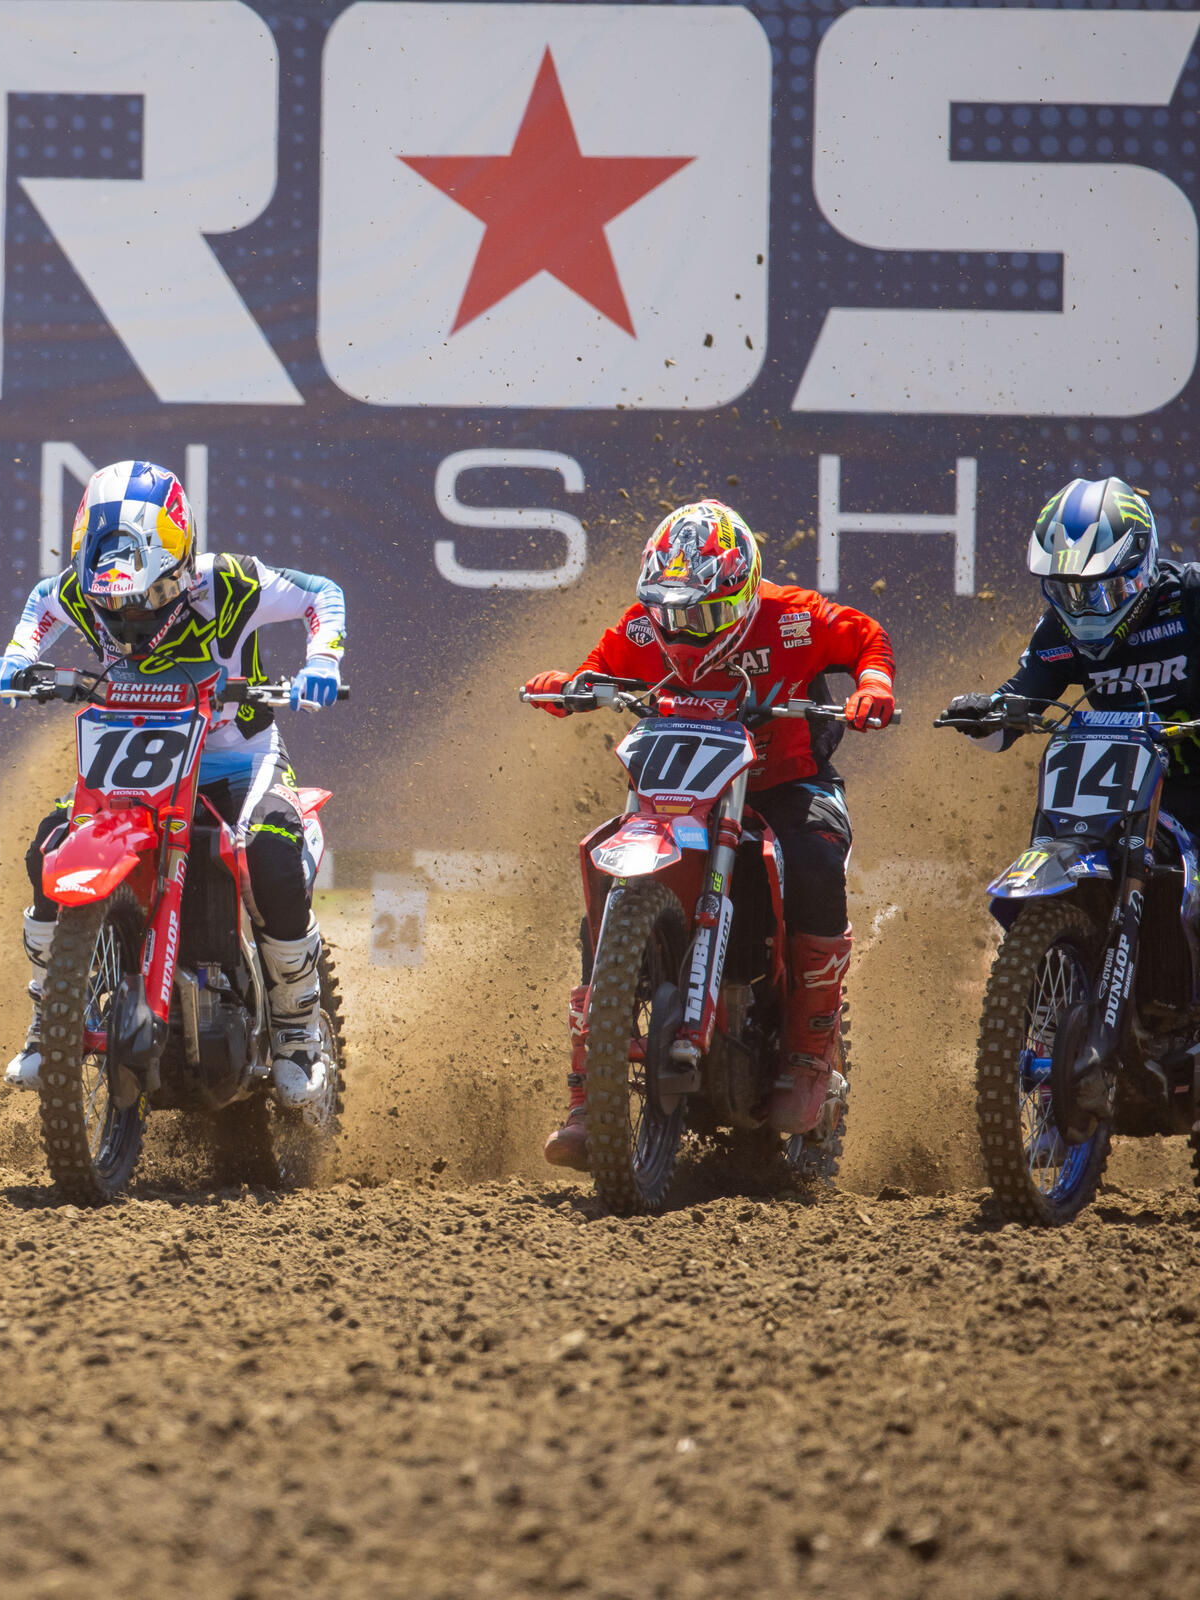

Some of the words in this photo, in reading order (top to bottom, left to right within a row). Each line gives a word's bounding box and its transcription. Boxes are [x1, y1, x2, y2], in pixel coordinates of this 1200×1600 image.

[91, 583, 112, 592] Red
[113, 583, 134, 592] Bull
[1139, 620, 1184, 643] YAMAHA
[112, 683, 183, 692] RENTHAL
[1089, 655, 1188, 695] THOR
[110, 694, 181, 702] RENTHAL
[1084, 712, 1141, 726] PROTAPER
[85, 729, 189, 790] 18
[626, 734, 747, 792] 107
[1046, 742, 1141, 811] 14
[54, 885, 96, 895] HONDA
[160, 910, 178, 1005] DUNLOP
[714, 910, 731, 990] DUNLOP
[1104, 933, 1130, 1028] DUNLOP
